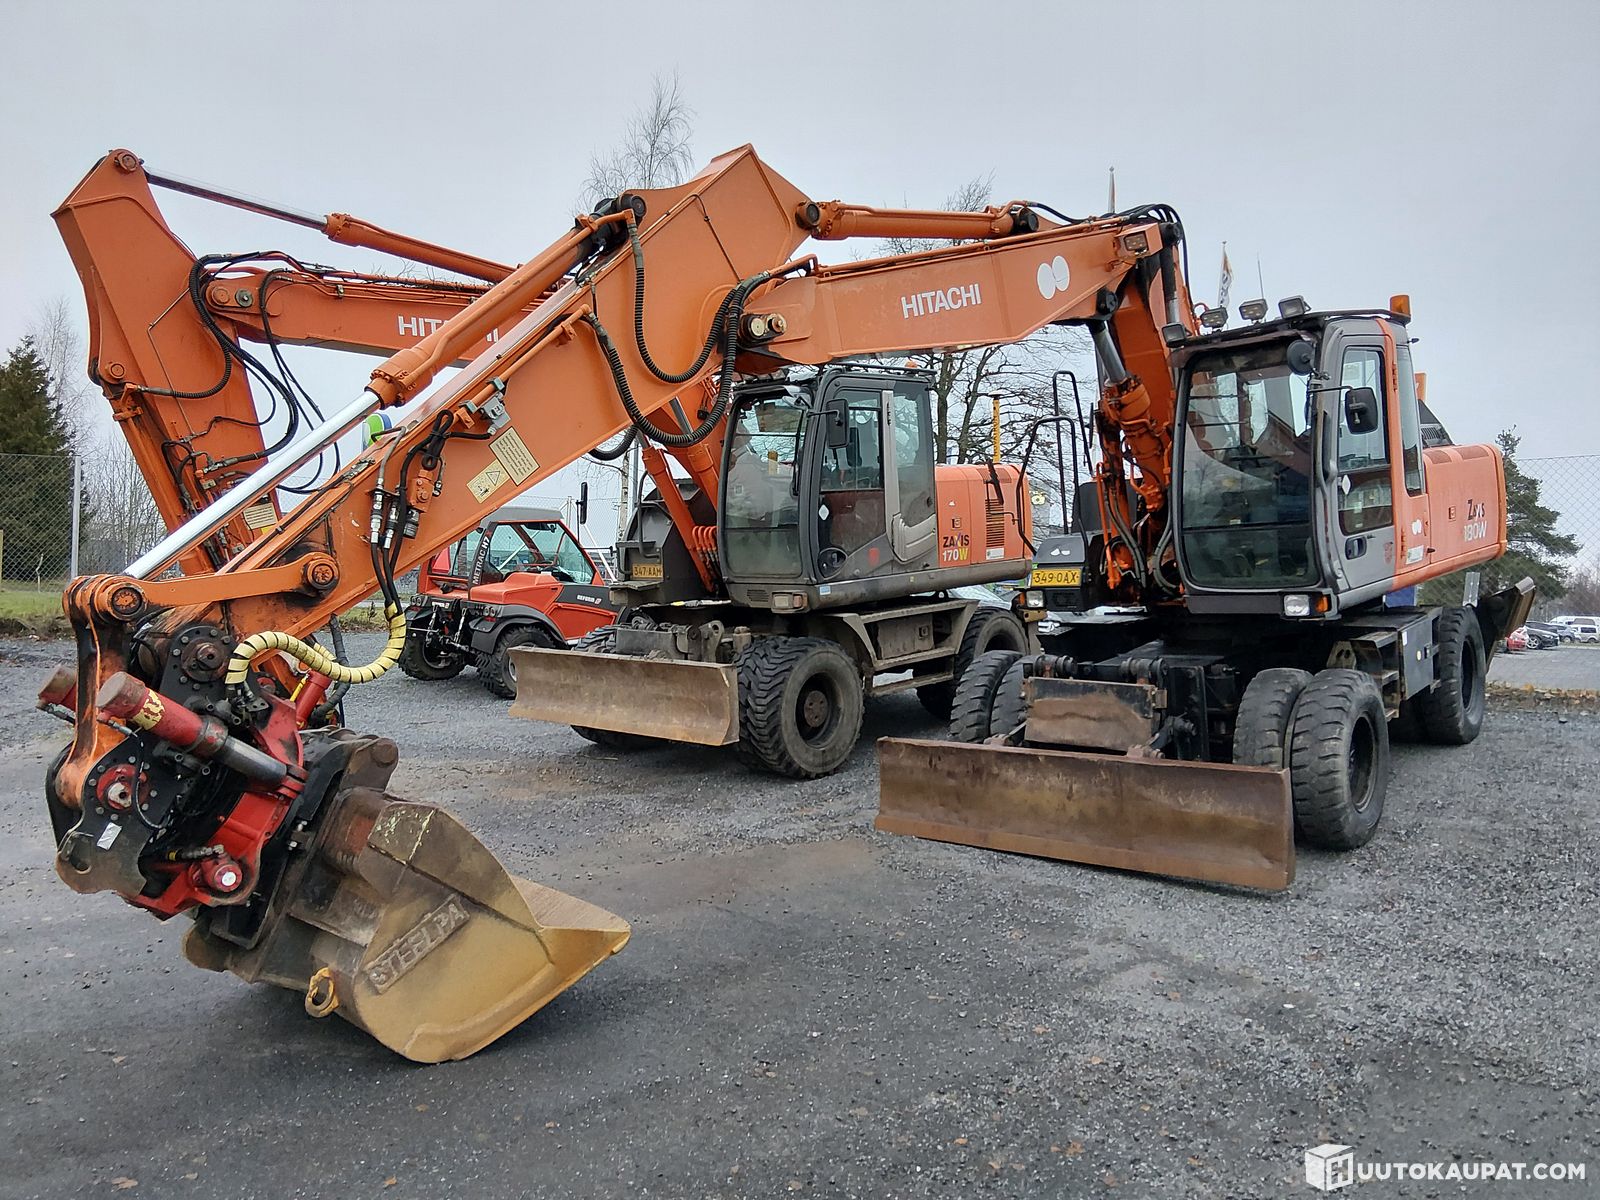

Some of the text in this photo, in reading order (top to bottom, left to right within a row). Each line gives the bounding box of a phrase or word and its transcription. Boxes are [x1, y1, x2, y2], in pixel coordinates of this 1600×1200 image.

[901, 283, 982, 319] HITACHI
[942, 533, 970, 549] ZAXIS
[1464, 520, 1487, 542] 180W
[942, 547, 969, 562] 170W
[472, 549, 486, 585] METRAC
